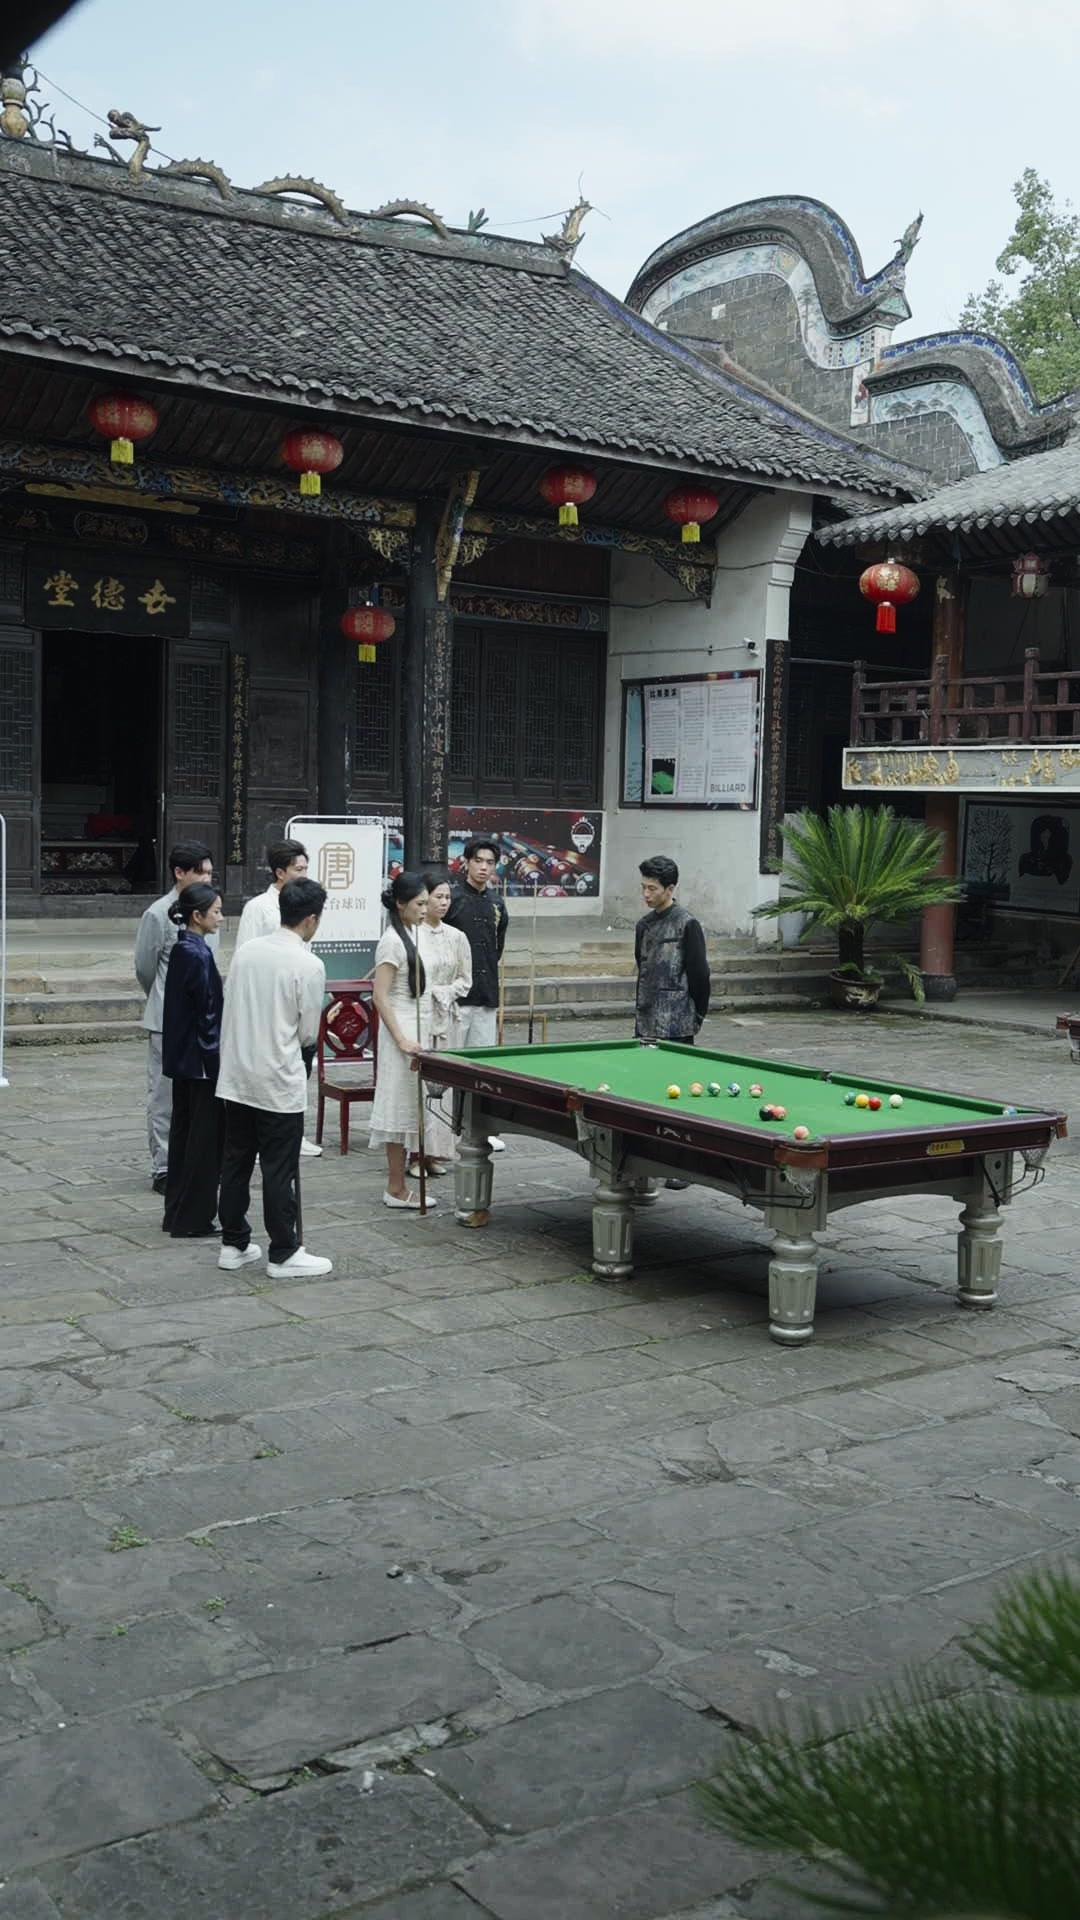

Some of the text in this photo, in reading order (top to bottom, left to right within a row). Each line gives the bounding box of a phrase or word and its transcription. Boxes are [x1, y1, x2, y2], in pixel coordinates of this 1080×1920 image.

[710, 783, 746, 793] BILLIARD
[324, 896, 367, 910] 台球馆
